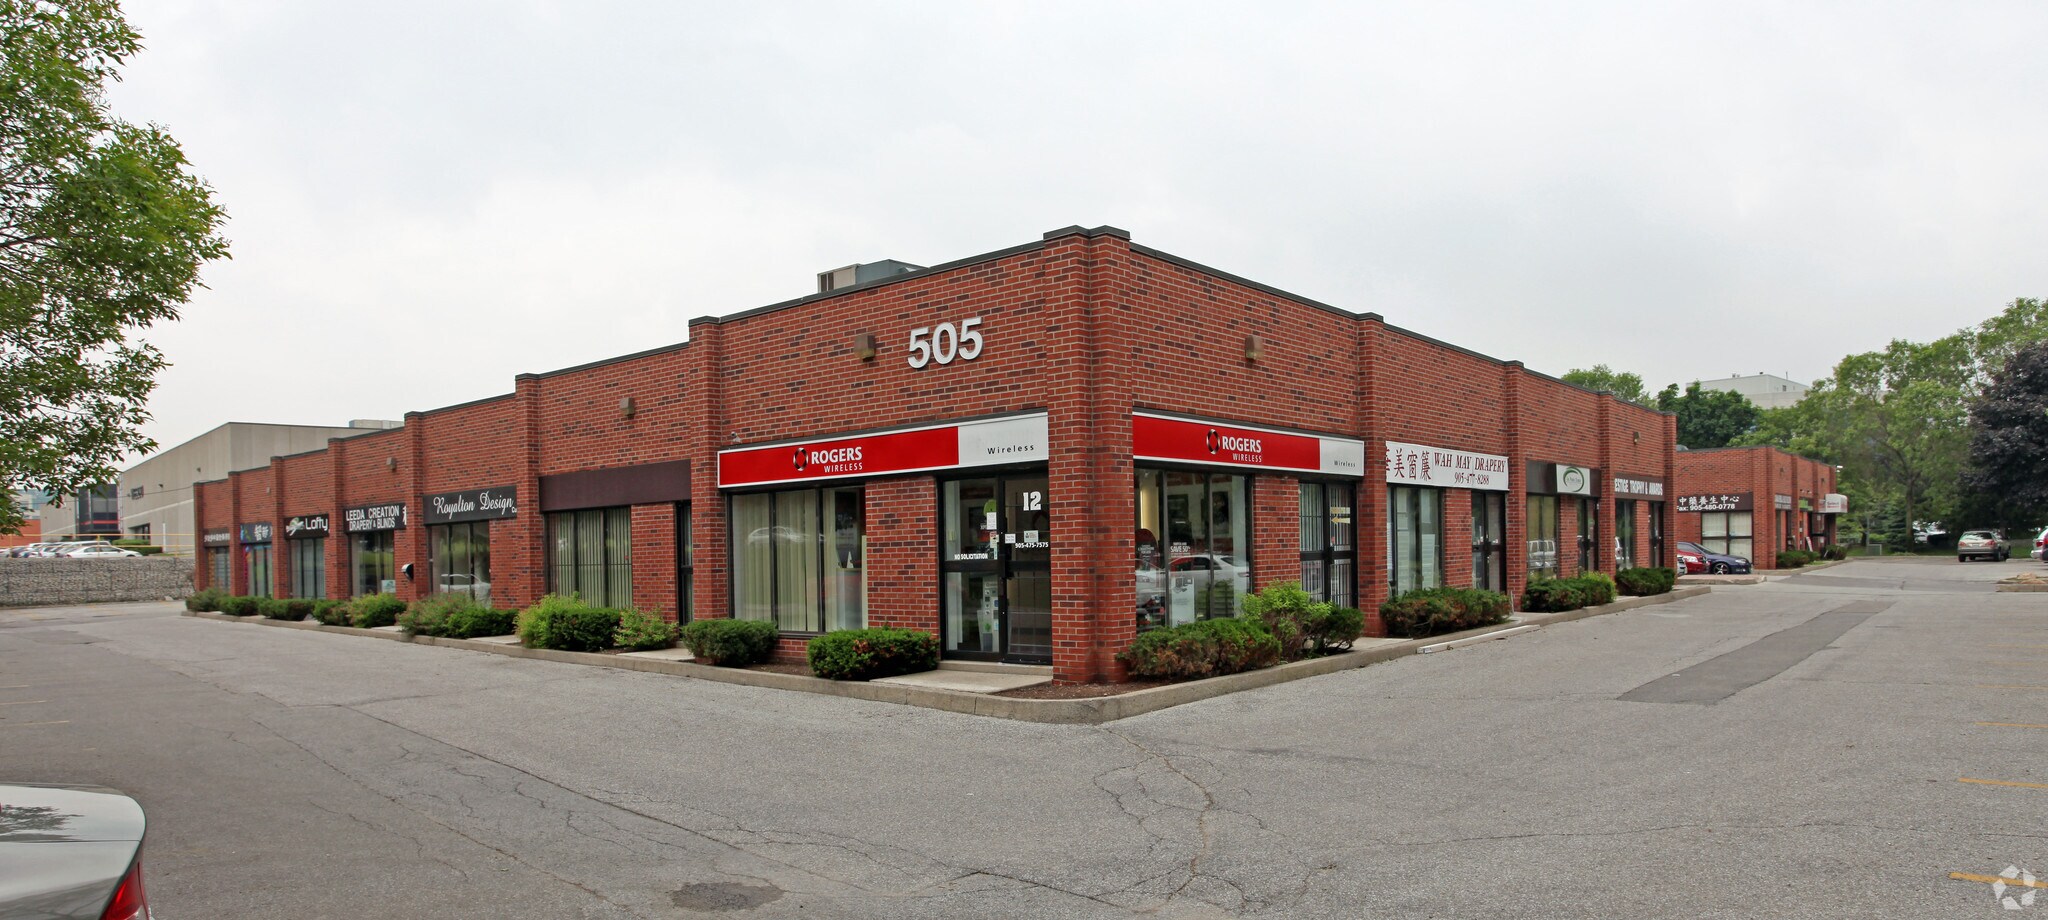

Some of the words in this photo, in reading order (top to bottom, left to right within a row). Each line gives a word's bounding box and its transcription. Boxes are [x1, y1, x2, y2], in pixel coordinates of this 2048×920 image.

[907, 316, 984, 369] 505
[987, 443, 1035, 455] Wireless
[1222, 435, 1262, 454] ROGERS
[811, 446, 863, 466] ROGERS
[1233, 453, 1262, 463] WIRELESS
[1334, 460, 1356, 468] Wireless
[1434, 452, 1452, 468] WAH
[1455, 455, 1472, 470] MAY
[1475, 457, 1506, 473] DRAPERY
[824, 462, 863, 474] WIRELESS
[1454, 472, 1490, 485] 905-477-8288
[1629, 480, 1645, 494] TROPHY
[1649, 482, 1663, 496] AWARDS
[433, 494, 475, 520] Royalton
[480, 490, 513, 515] Design
[1023, 491, 1041, 511] 12
[345, 508, 365, 521] LEEDA
[368, 505, 399, 519] CREATION
[305, 516, 328, 531] Lofty
[349, 519, 372, 531] DRAPERY
[377, 517, 395, 529] BLINDS
